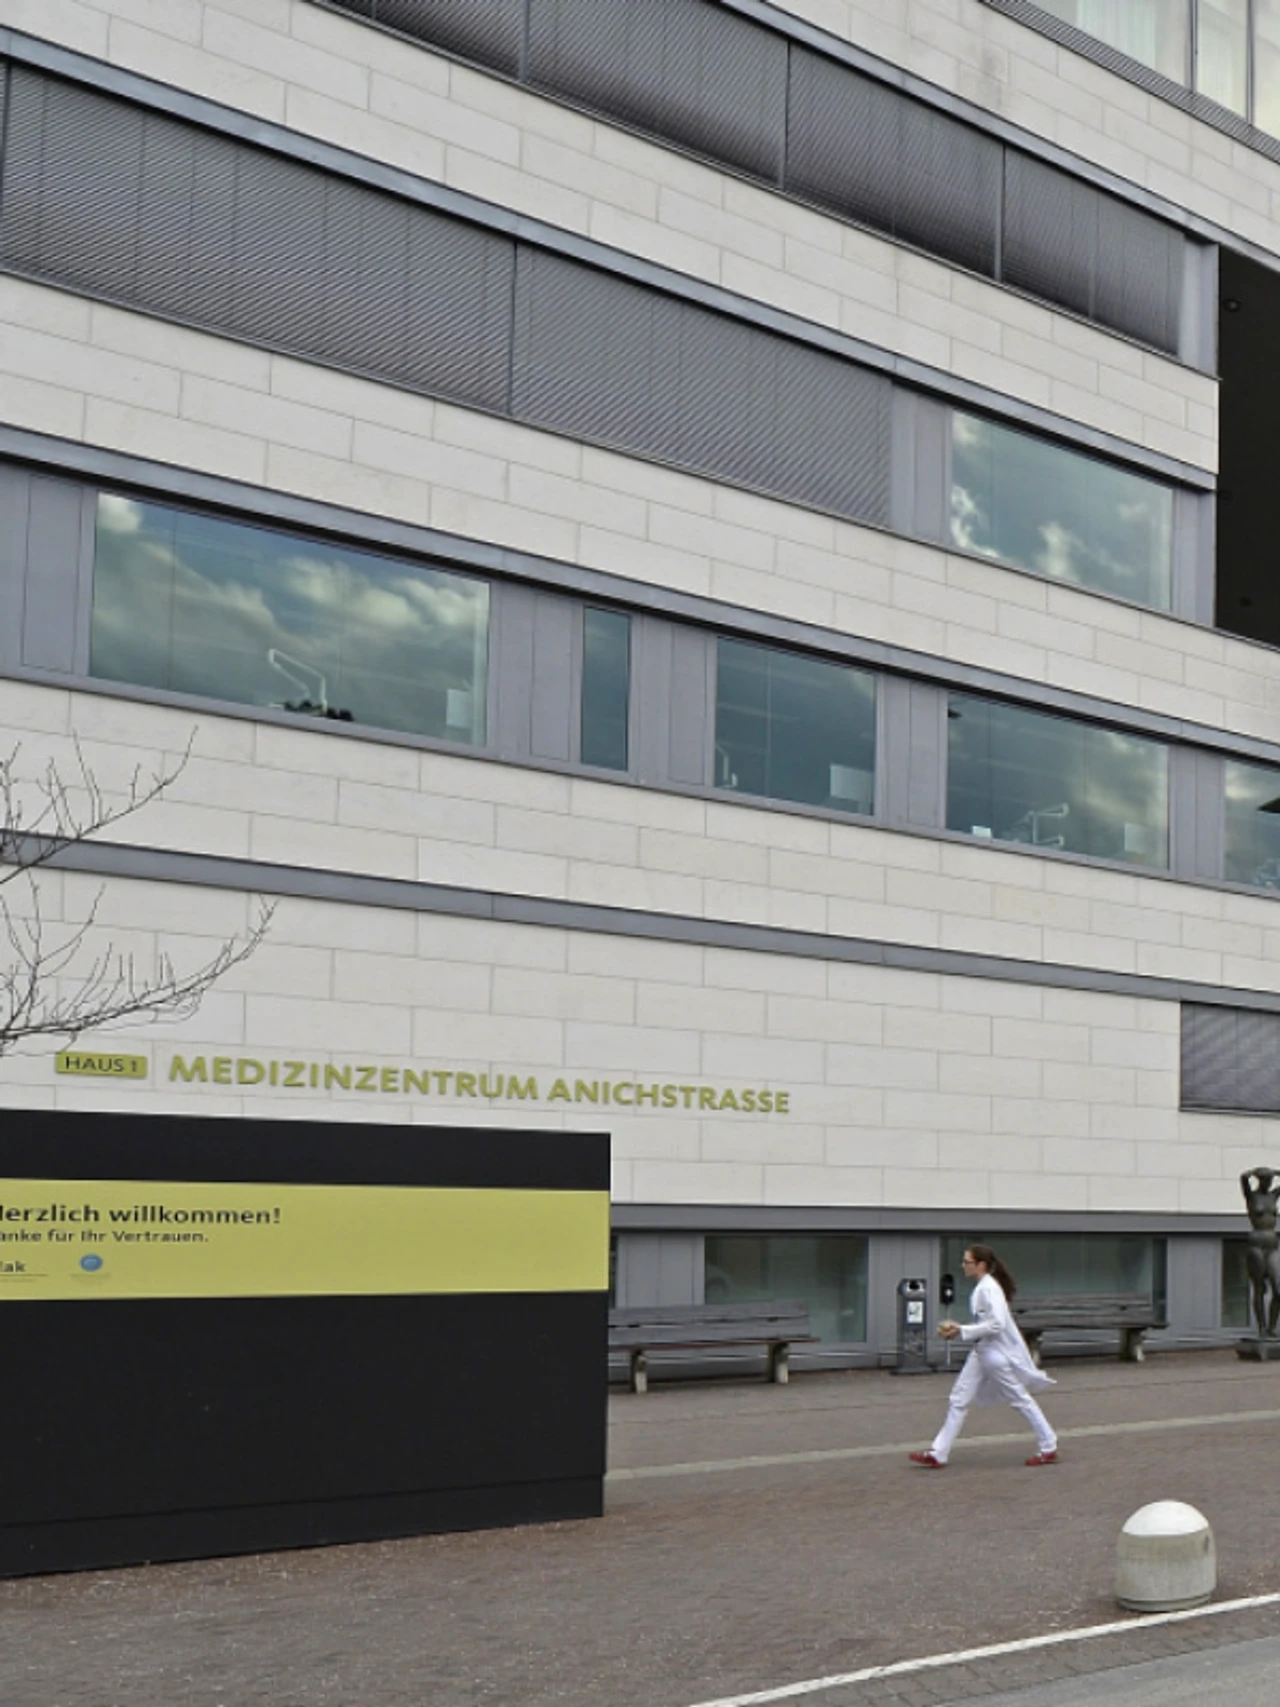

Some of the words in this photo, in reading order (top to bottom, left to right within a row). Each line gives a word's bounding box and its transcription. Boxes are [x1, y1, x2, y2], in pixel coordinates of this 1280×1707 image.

[65, 1055, 125, 1073] HAUS
[131, 1059, 138, 1073] 1
[169, 1054, 539, 1101] MEDIZINZENTRUM
[546, 1077, 791, 1114] ANICHSTRASSE
[109, 1204, 281, 1225] willkommen!
[47, 1227, 75, 1243] für
[81, 1228, 107, 1243] Ihr
[112, 1229, 209, 1244] Vertrauen.
